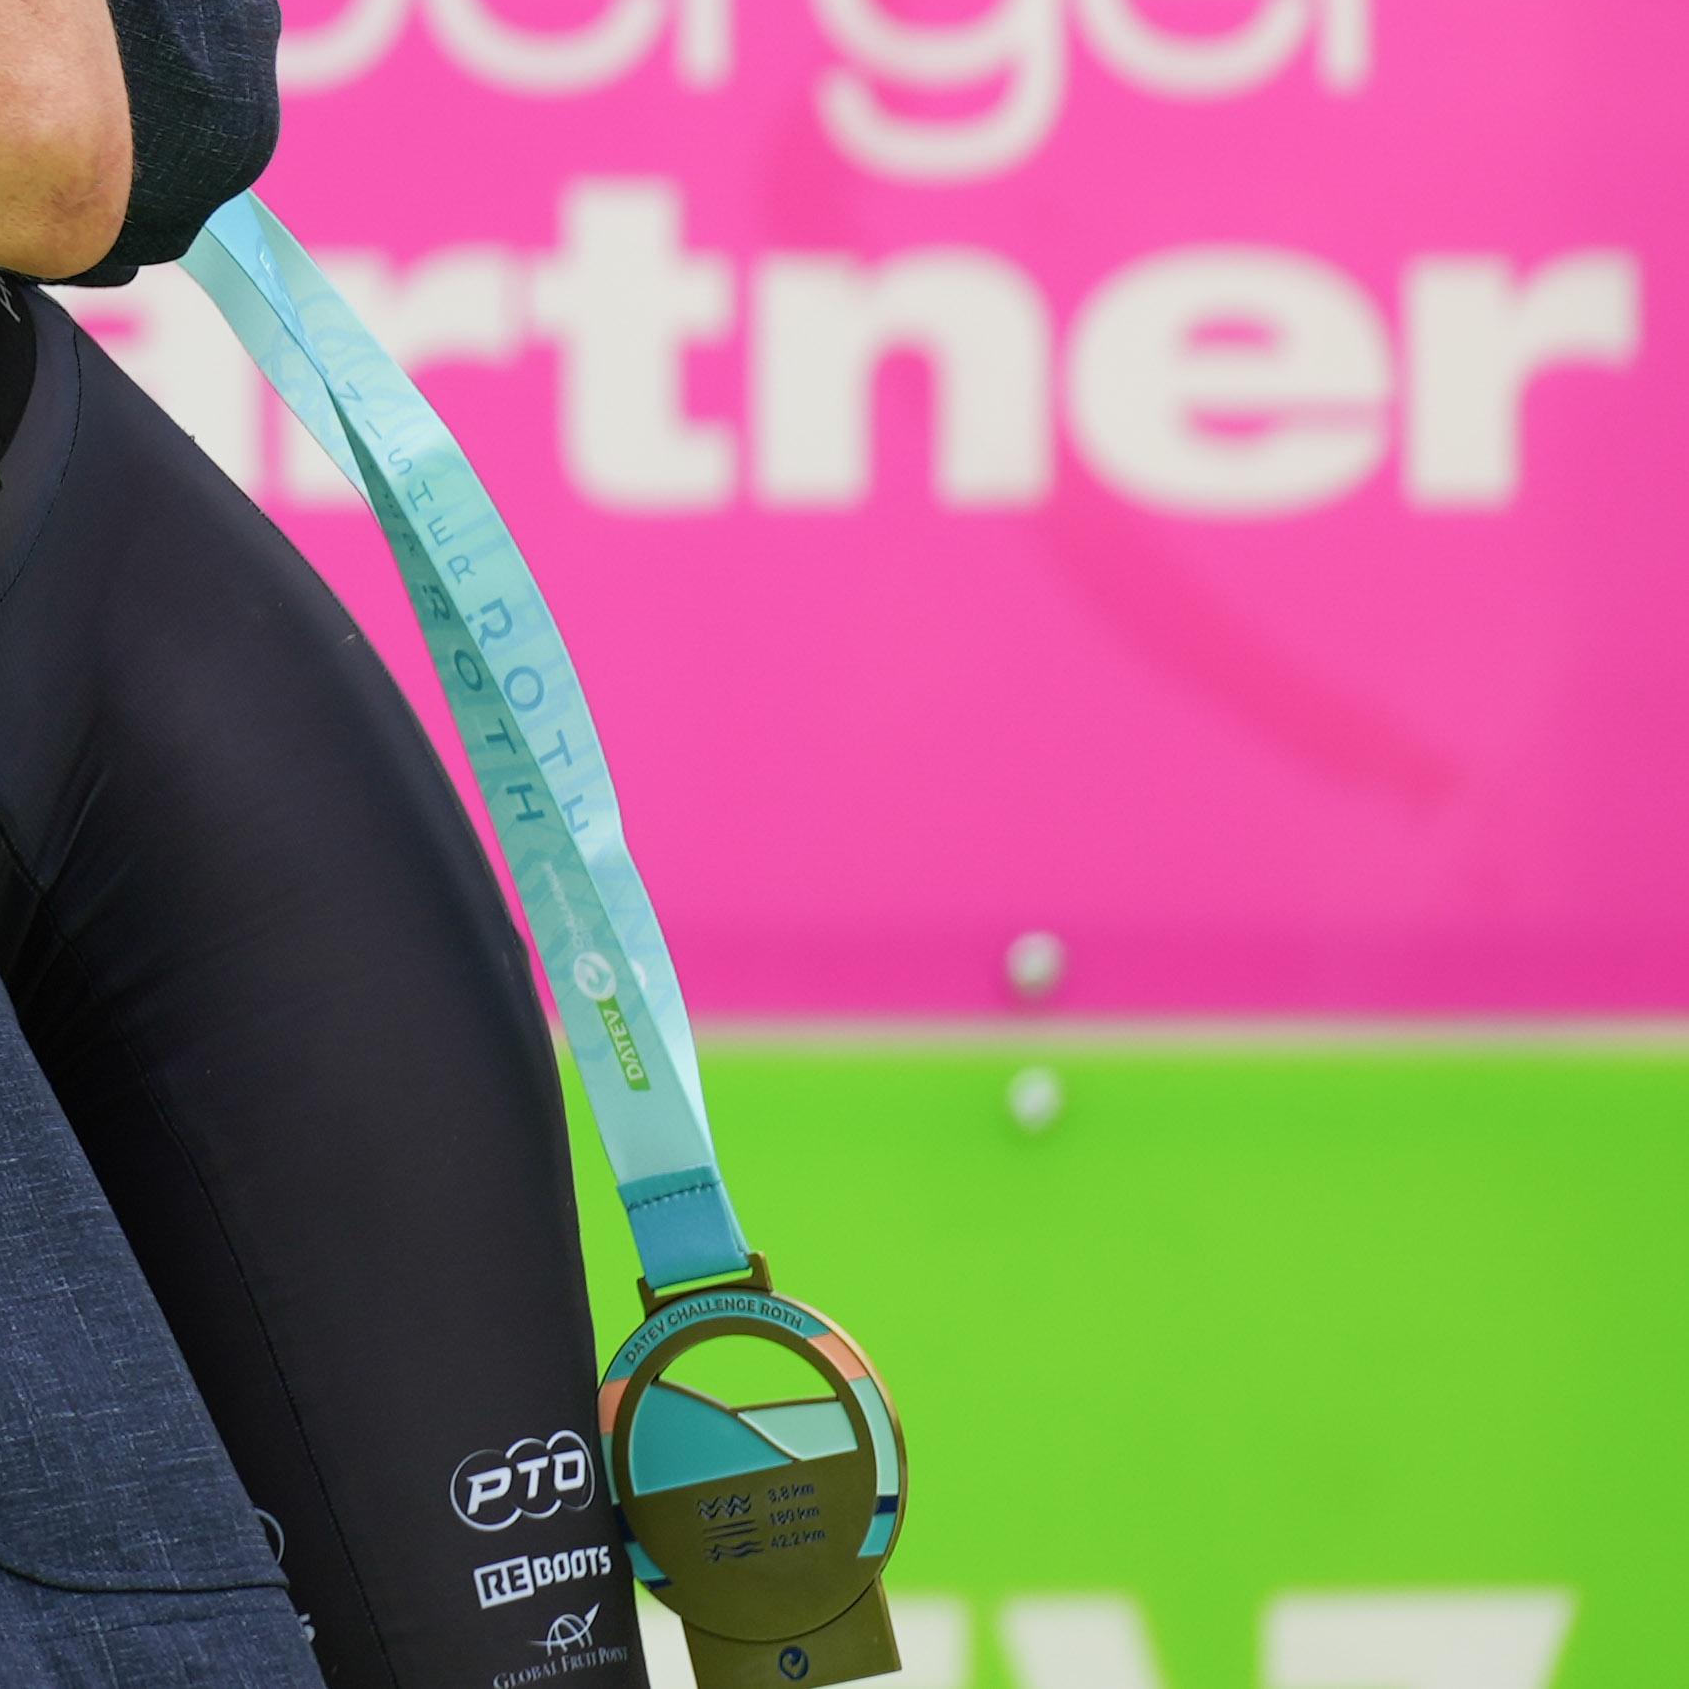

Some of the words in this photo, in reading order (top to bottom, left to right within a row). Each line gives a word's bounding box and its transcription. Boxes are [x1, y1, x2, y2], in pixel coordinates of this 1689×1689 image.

[602, 1007, 646, 1084] DATEV
[625, 1321, 666, 1365] DATEV
[668, 1296, 756, 1328] CHALLENGE
[760, 1301, 804, 1330] ROTH
[466, 1448, 587, 1516] PTO
